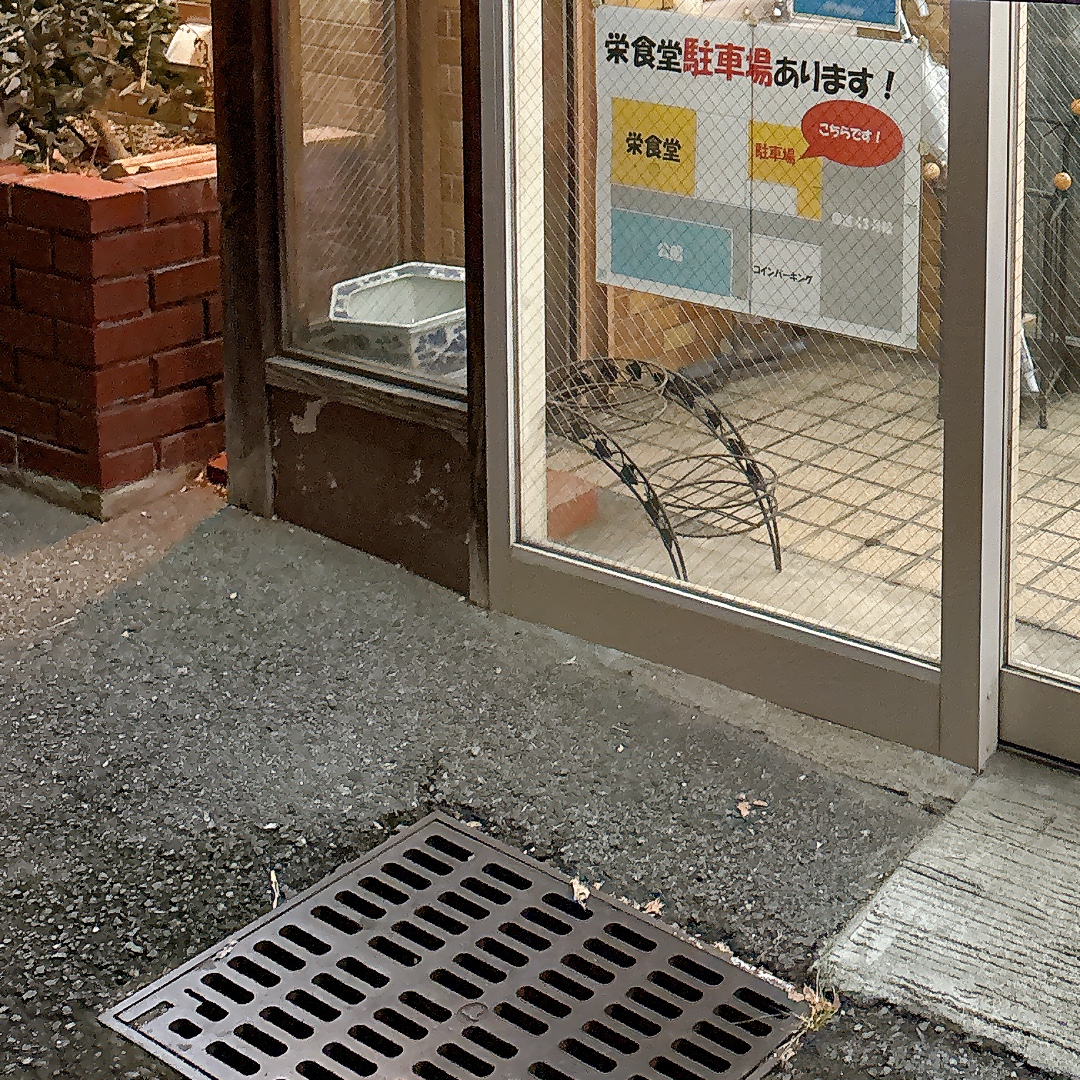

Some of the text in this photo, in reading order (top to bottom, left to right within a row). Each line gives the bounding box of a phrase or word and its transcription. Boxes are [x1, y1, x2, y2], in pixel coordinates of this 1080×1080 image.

[625, 132, 682, 162] 栄食堂
[755, 142, 796, 166] 駐車場
